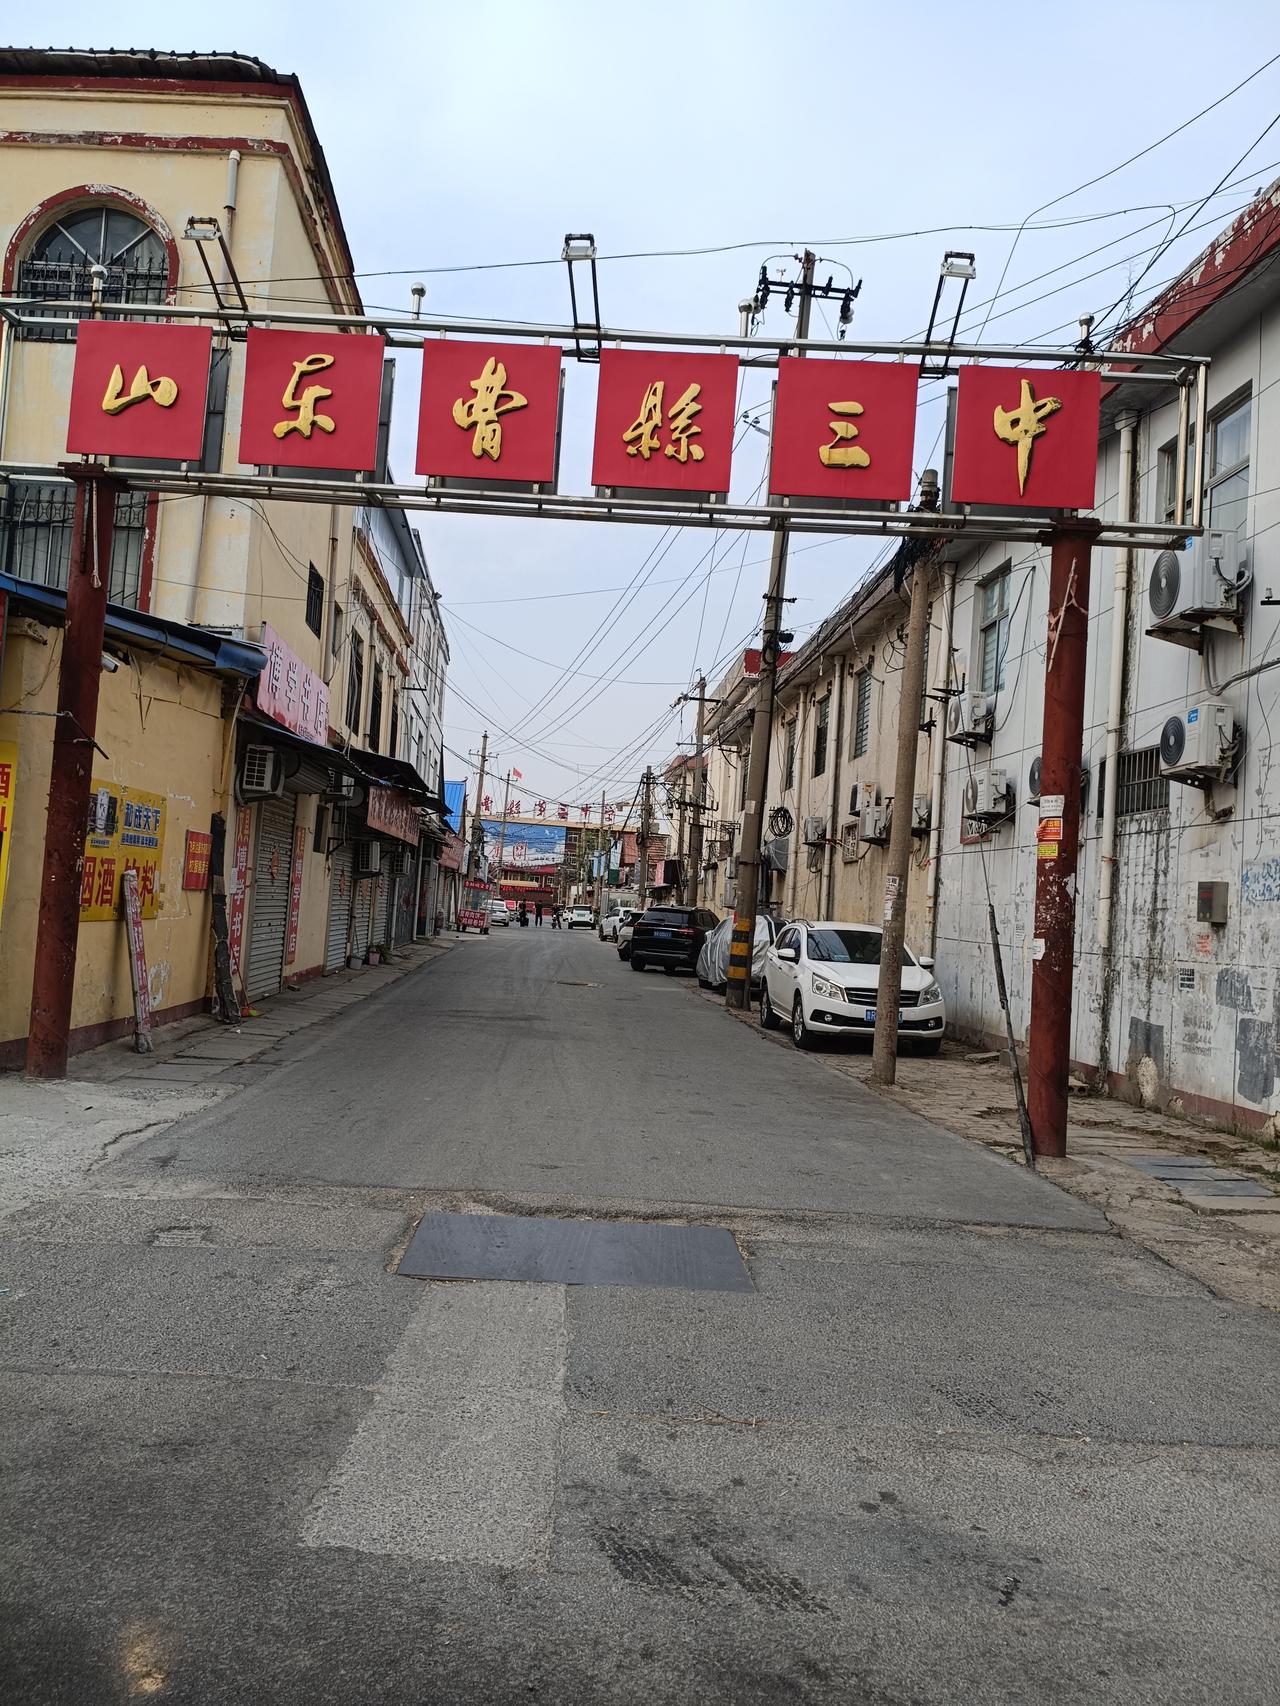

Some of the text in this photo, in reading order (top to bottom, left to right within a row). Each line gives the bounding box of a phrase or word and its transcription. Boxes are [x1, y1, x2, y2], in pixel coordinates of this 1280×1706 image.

[269, 642, 324, 735] 博学书店
[124, 800, 161, 833] 和成天下
[288, 859, 304, 952] 博学书店
